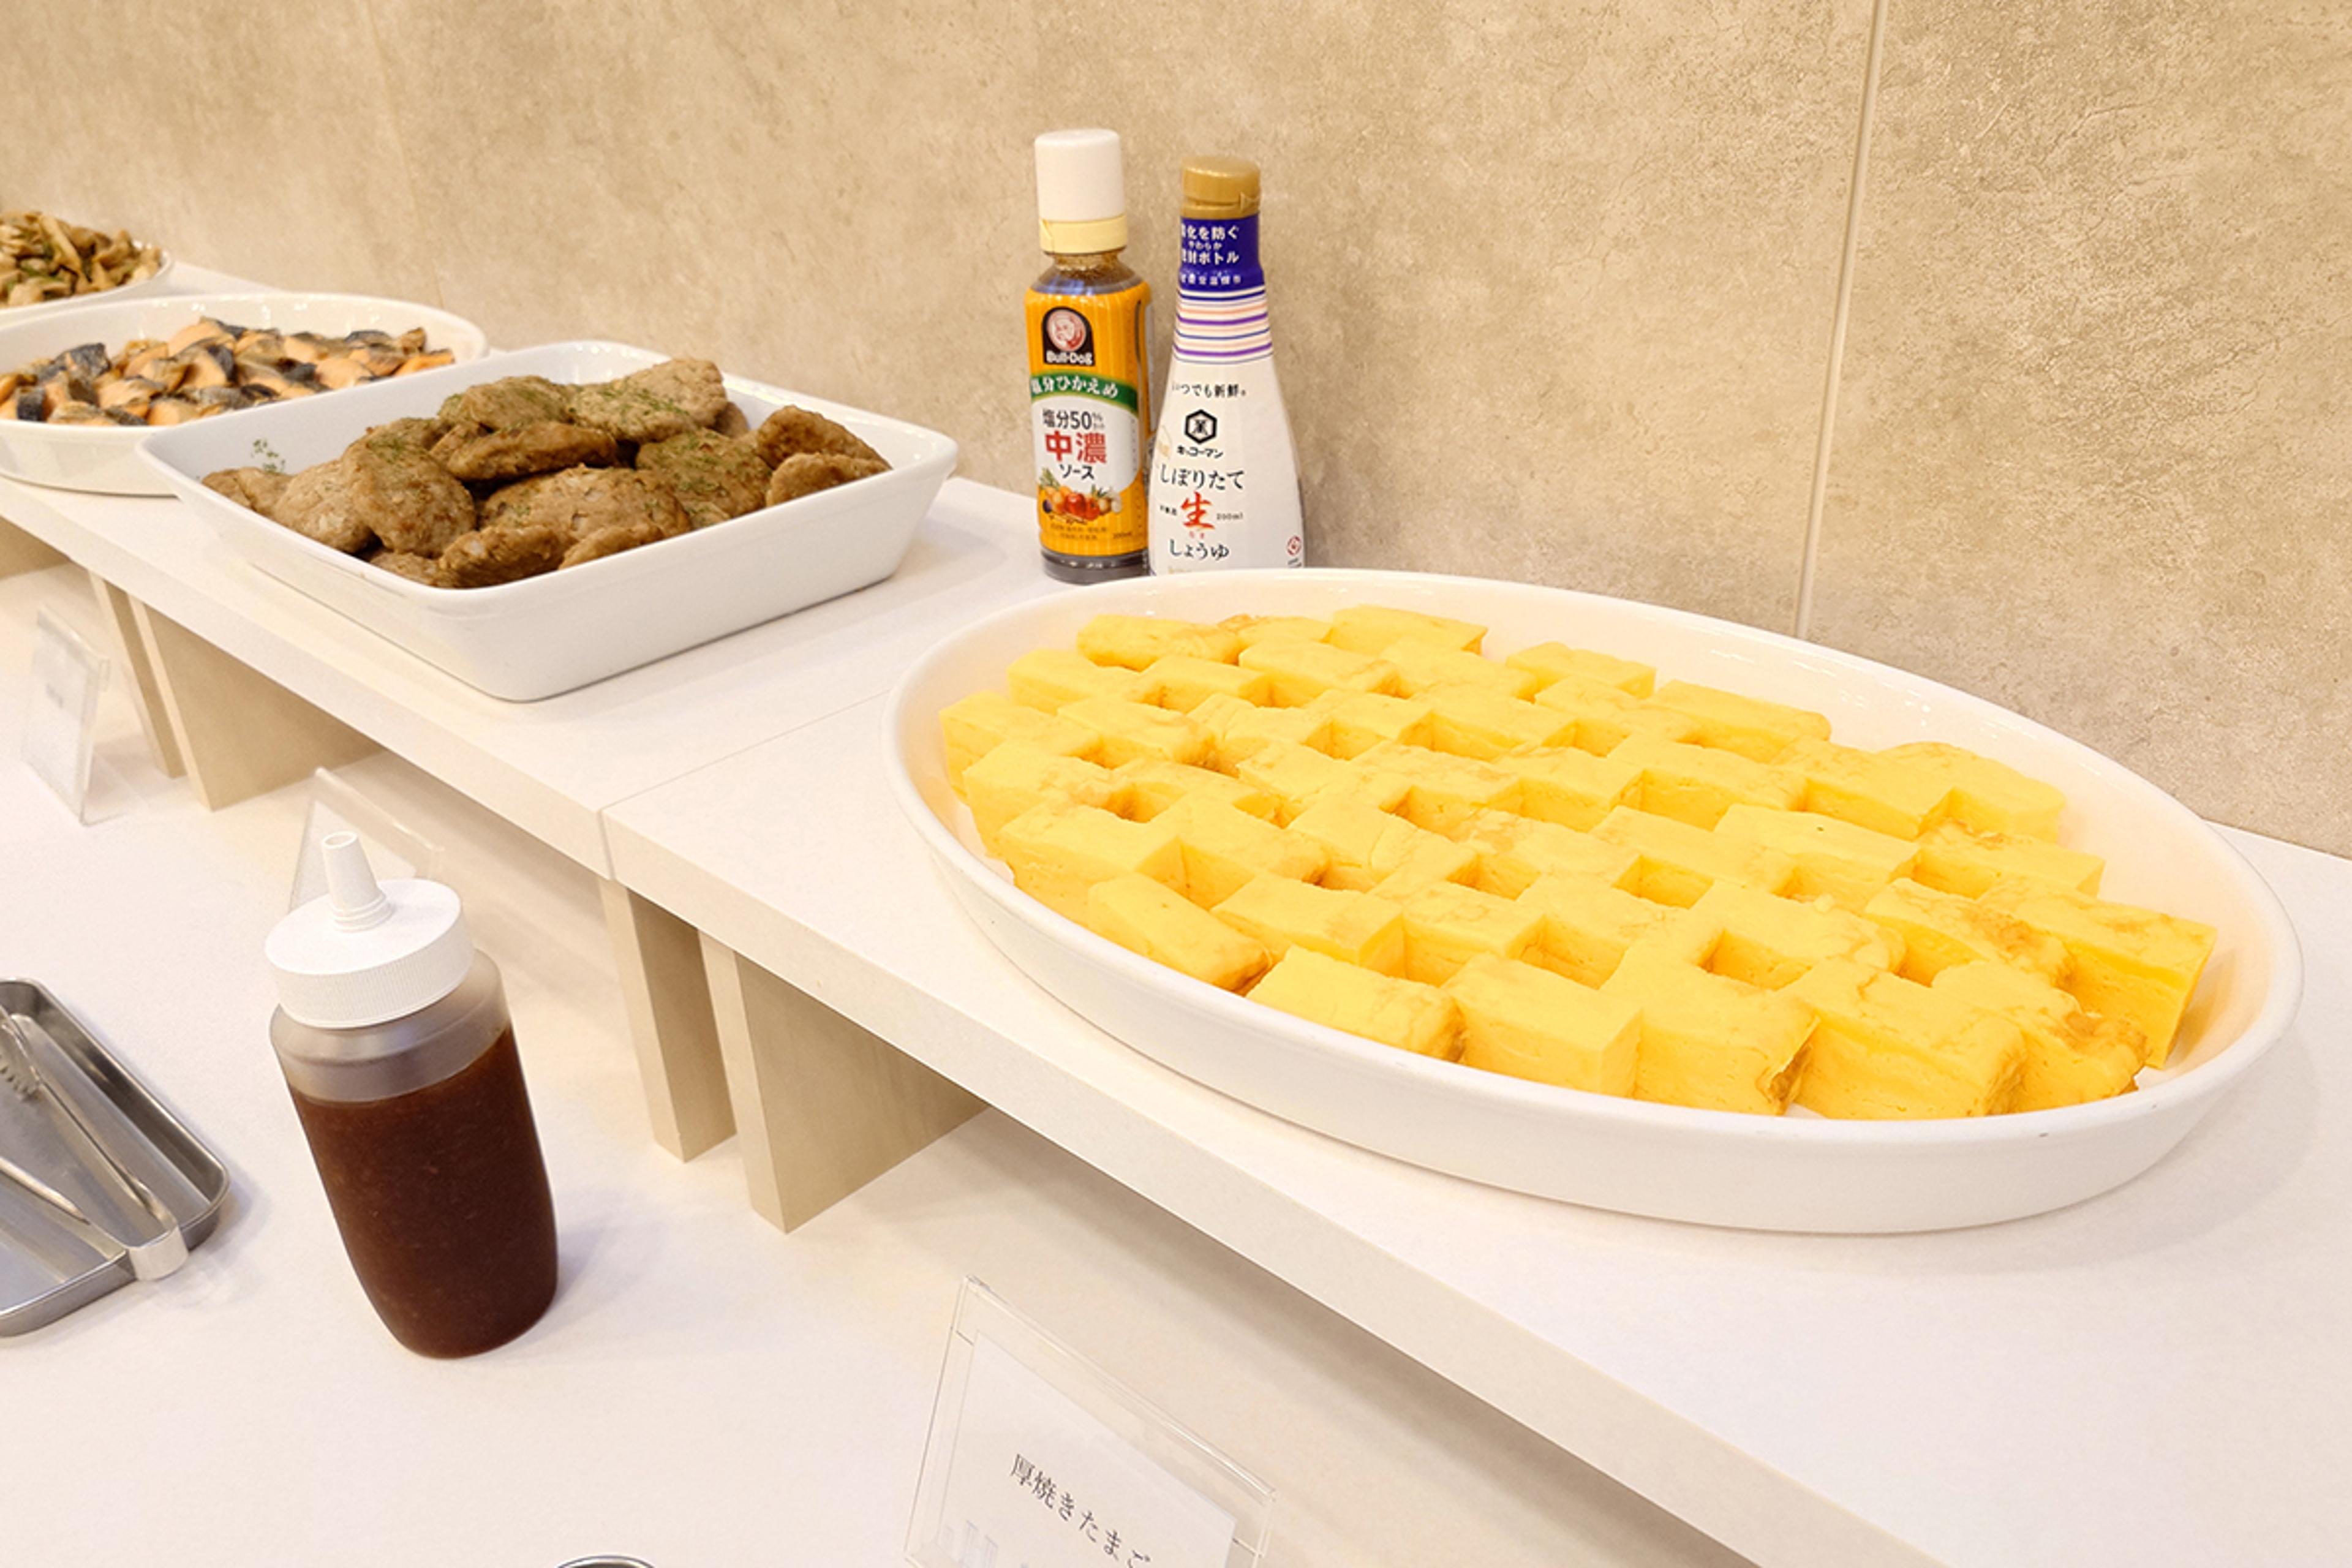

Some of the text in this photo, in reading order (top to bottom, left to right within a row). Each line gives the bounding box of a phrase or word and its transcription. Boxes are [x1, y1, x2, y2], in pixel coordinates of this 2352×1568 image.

[1045, 430, 1107, 464] 中濃
[1059, 464, 1095, 480] ソース
[1161, 463, 1245, 490] しぼりたて
[1180, 491, 1215, 529] 生
[1170, 538, 1229, 560] しょうゆ
